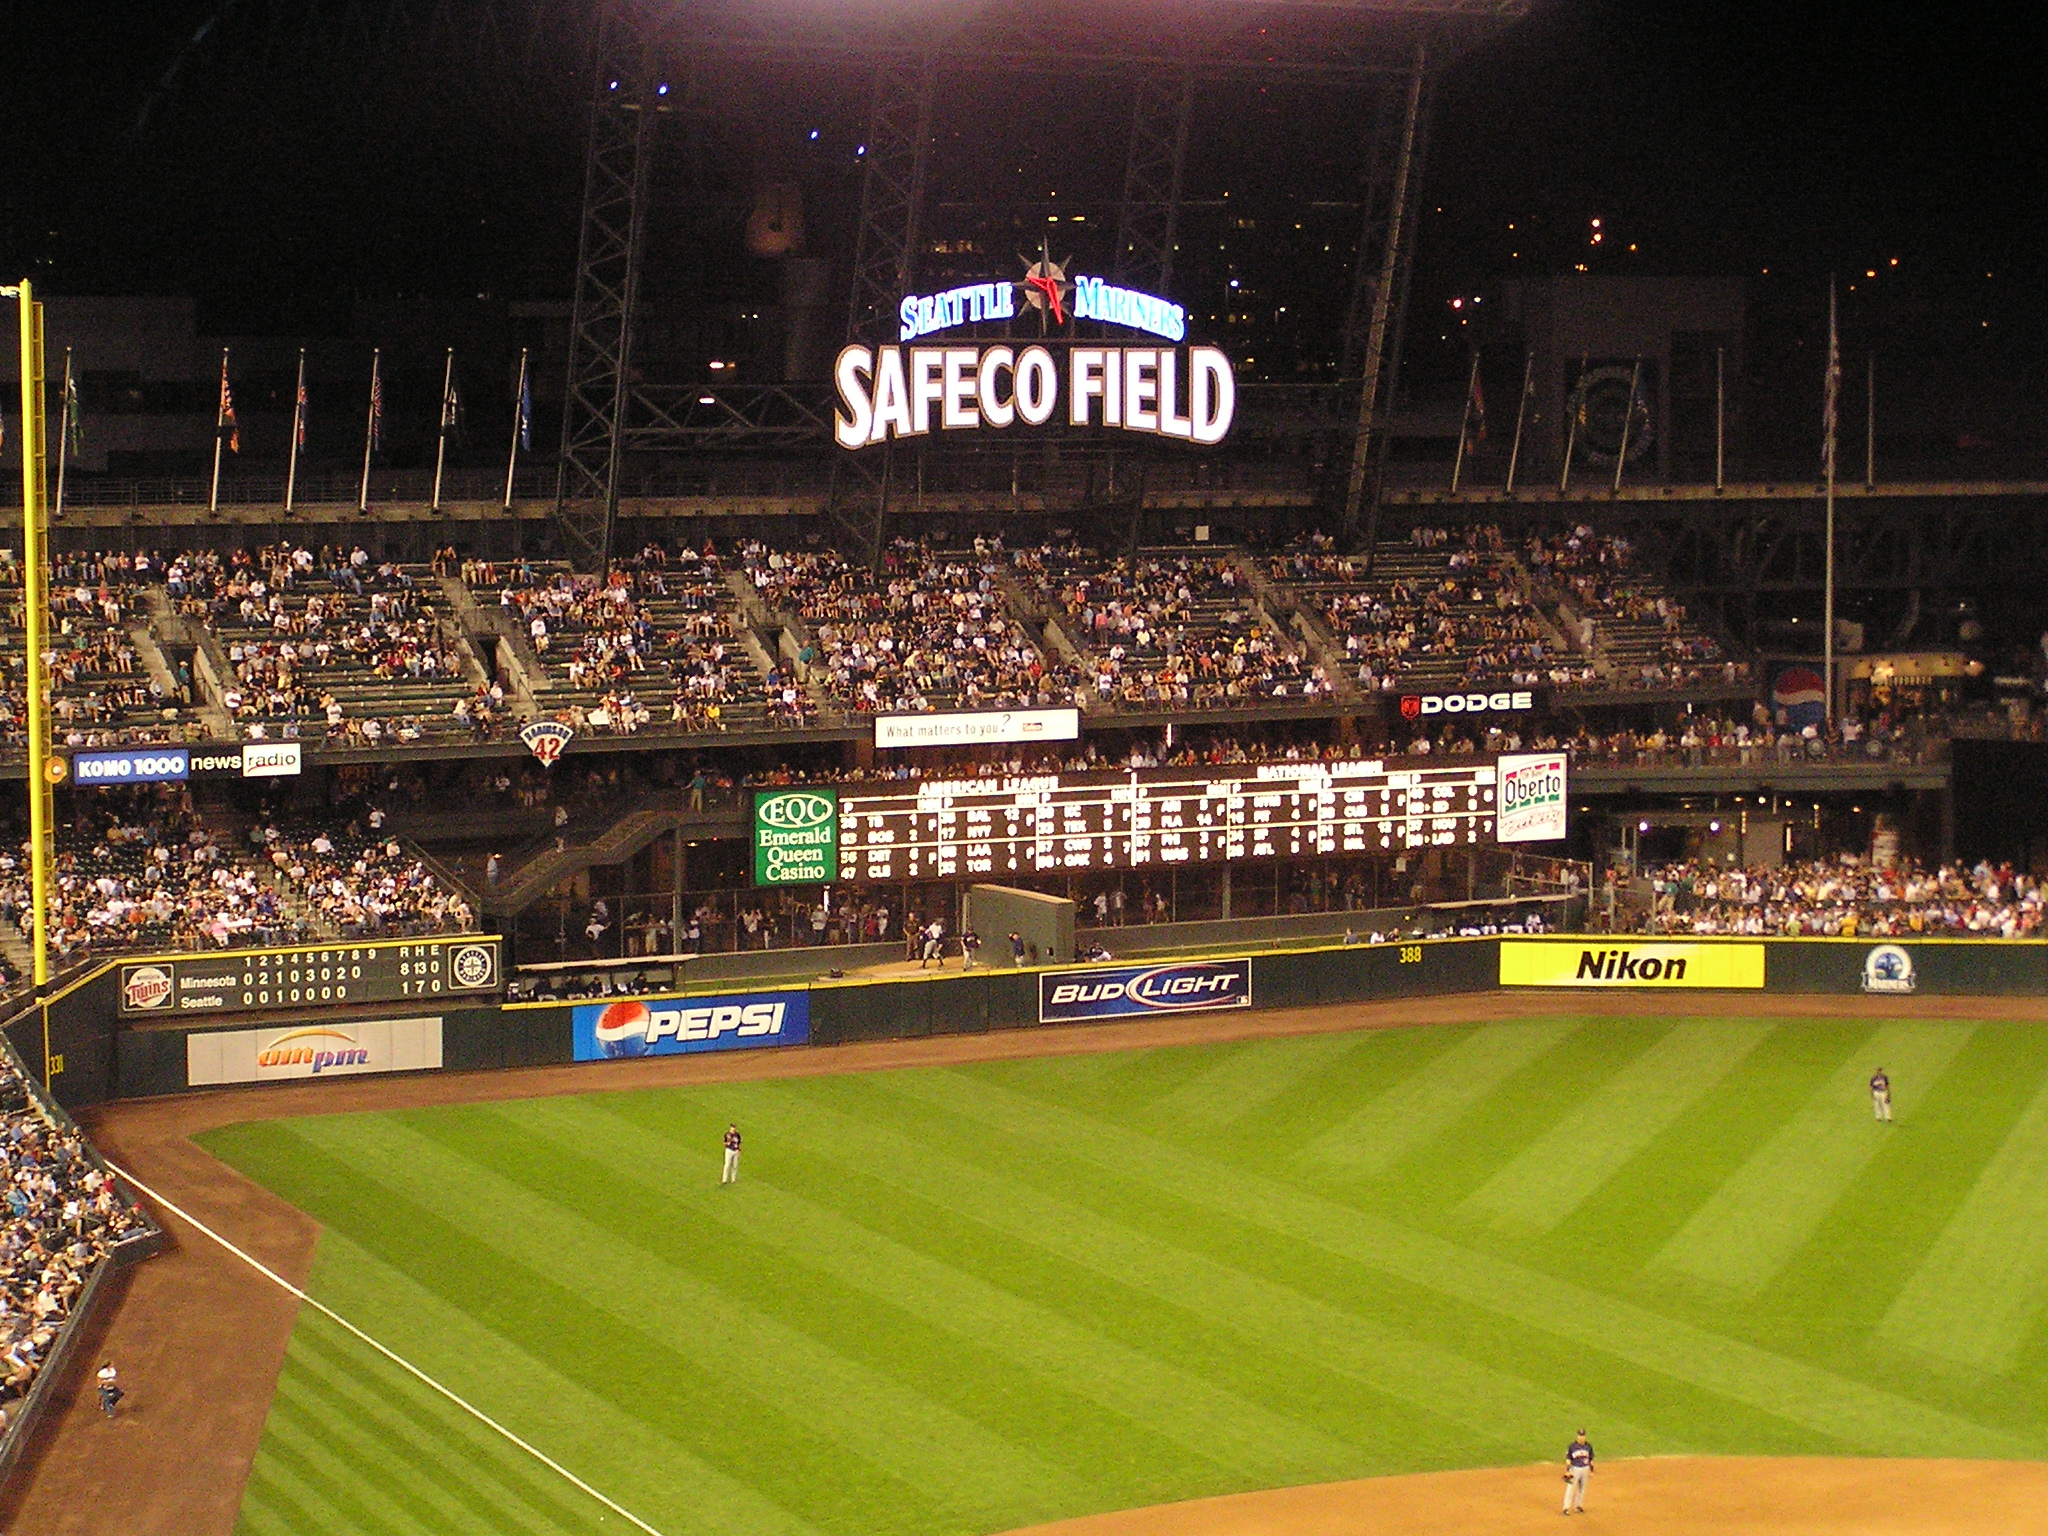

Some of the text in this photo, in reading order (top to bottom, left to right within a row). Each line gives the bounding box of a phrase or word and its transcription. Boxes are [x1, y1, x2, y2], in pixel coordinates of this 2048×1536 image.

[900, 276, 1185, 342] SEATTLE MARINERS
[834, 344, 1235, 450] SAFECO FIELD
[1421, 692, 1532, 714] DODGE
[886, 725, 913, 737] What
[918, 725, 961, 736] matters
[965, 724, 976, 734] to
[533, 737, 560, 760] 42
[78, 751, 296, 778] KOMO 1000 news radio
[1257, 763, 1328, 779] NATIONAL
[919, 776, 1058, 796] AMERICAN LEAGUE
[1505, 774, 1560, 805] Oberto
[770, 798, 829, 826] EQC
[909, 813, 917, 825] 1
[1468, 816, 1476, 828] 7
[759, 826, 831, 846] Emerald
[909, 829, 917, 841] 2
[942, 827, 956, 839] 17
[1467, 830, 1476, 843] 2
[1483, 820, 1492, 833] 7
[767, 847, 823, 867] Queen
[1008, 842, 1015, 854] 1
[766, 863, 825, 881] Casino
[909, 863, 918, 876] 2
[245, 945, 439, 967] 1 2 3 4 5 6 7 8 9 R H E
[1400, 946, 1421, 963] 388
[180, 961, 439, 989] Minnesota 0 2 1 0 3 0 2 0 8 13 0
[1576, 951, 1687, 980] Nikon
[126, 981, 169, 1003] Twins
[181, 980, 440, 1008] Seattle 0 0 1 0 0 0 0 1 7 0
[1051, 974, 1239, 1003] BUD LIGHT
[645, 1002, 786, 1043] PEPSI
[258, 1047, 369, 1073] ampm
